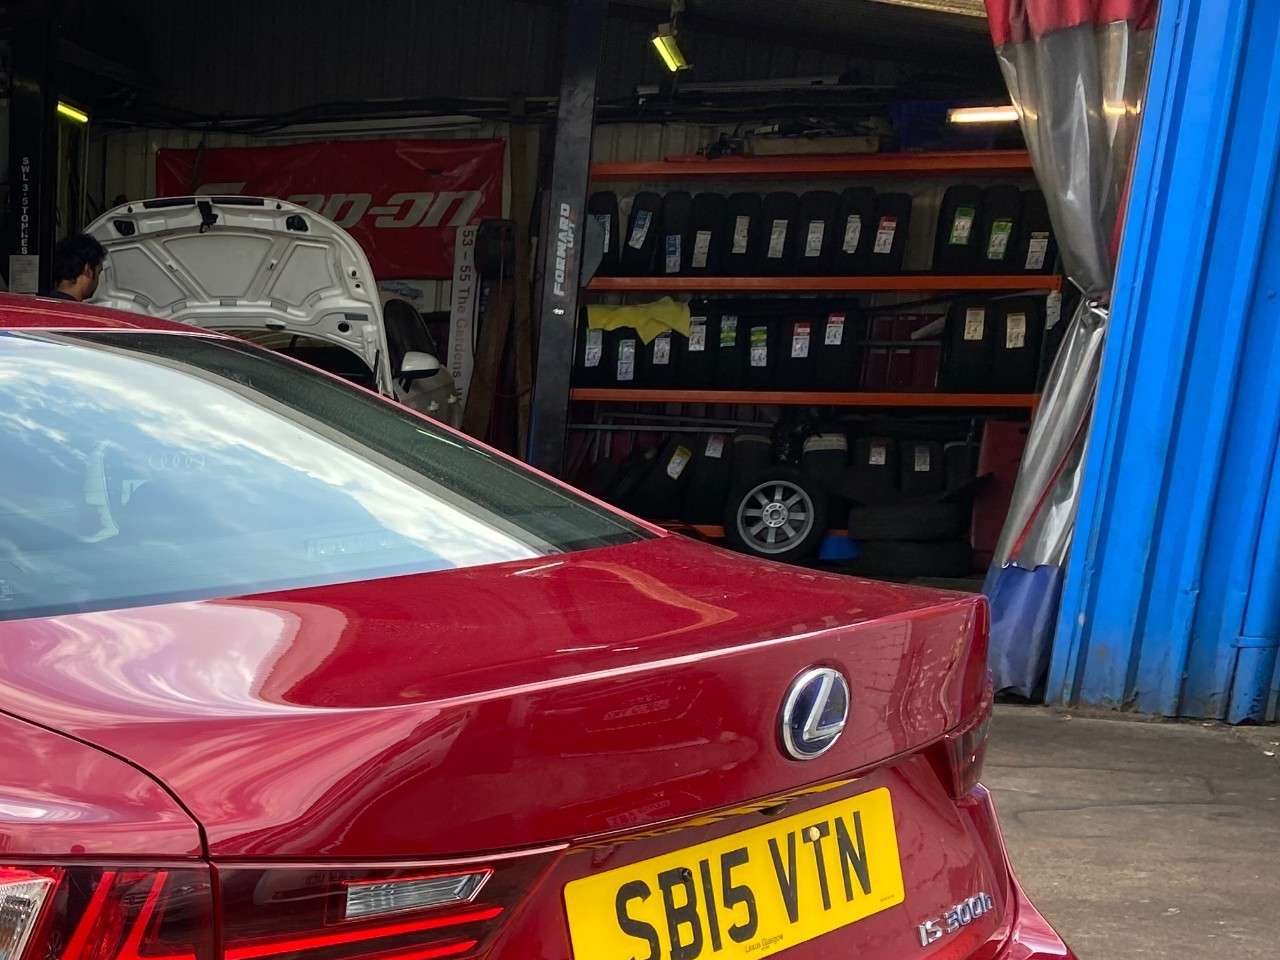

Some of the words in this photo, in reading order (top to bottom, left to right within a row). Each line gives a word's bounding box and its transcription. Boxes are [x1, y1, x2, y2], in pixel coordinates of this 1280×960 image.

[462, 230, 473, 247] 53
[768, 810, 872, 924] VTN
[919, 918, 943, 946] IS
